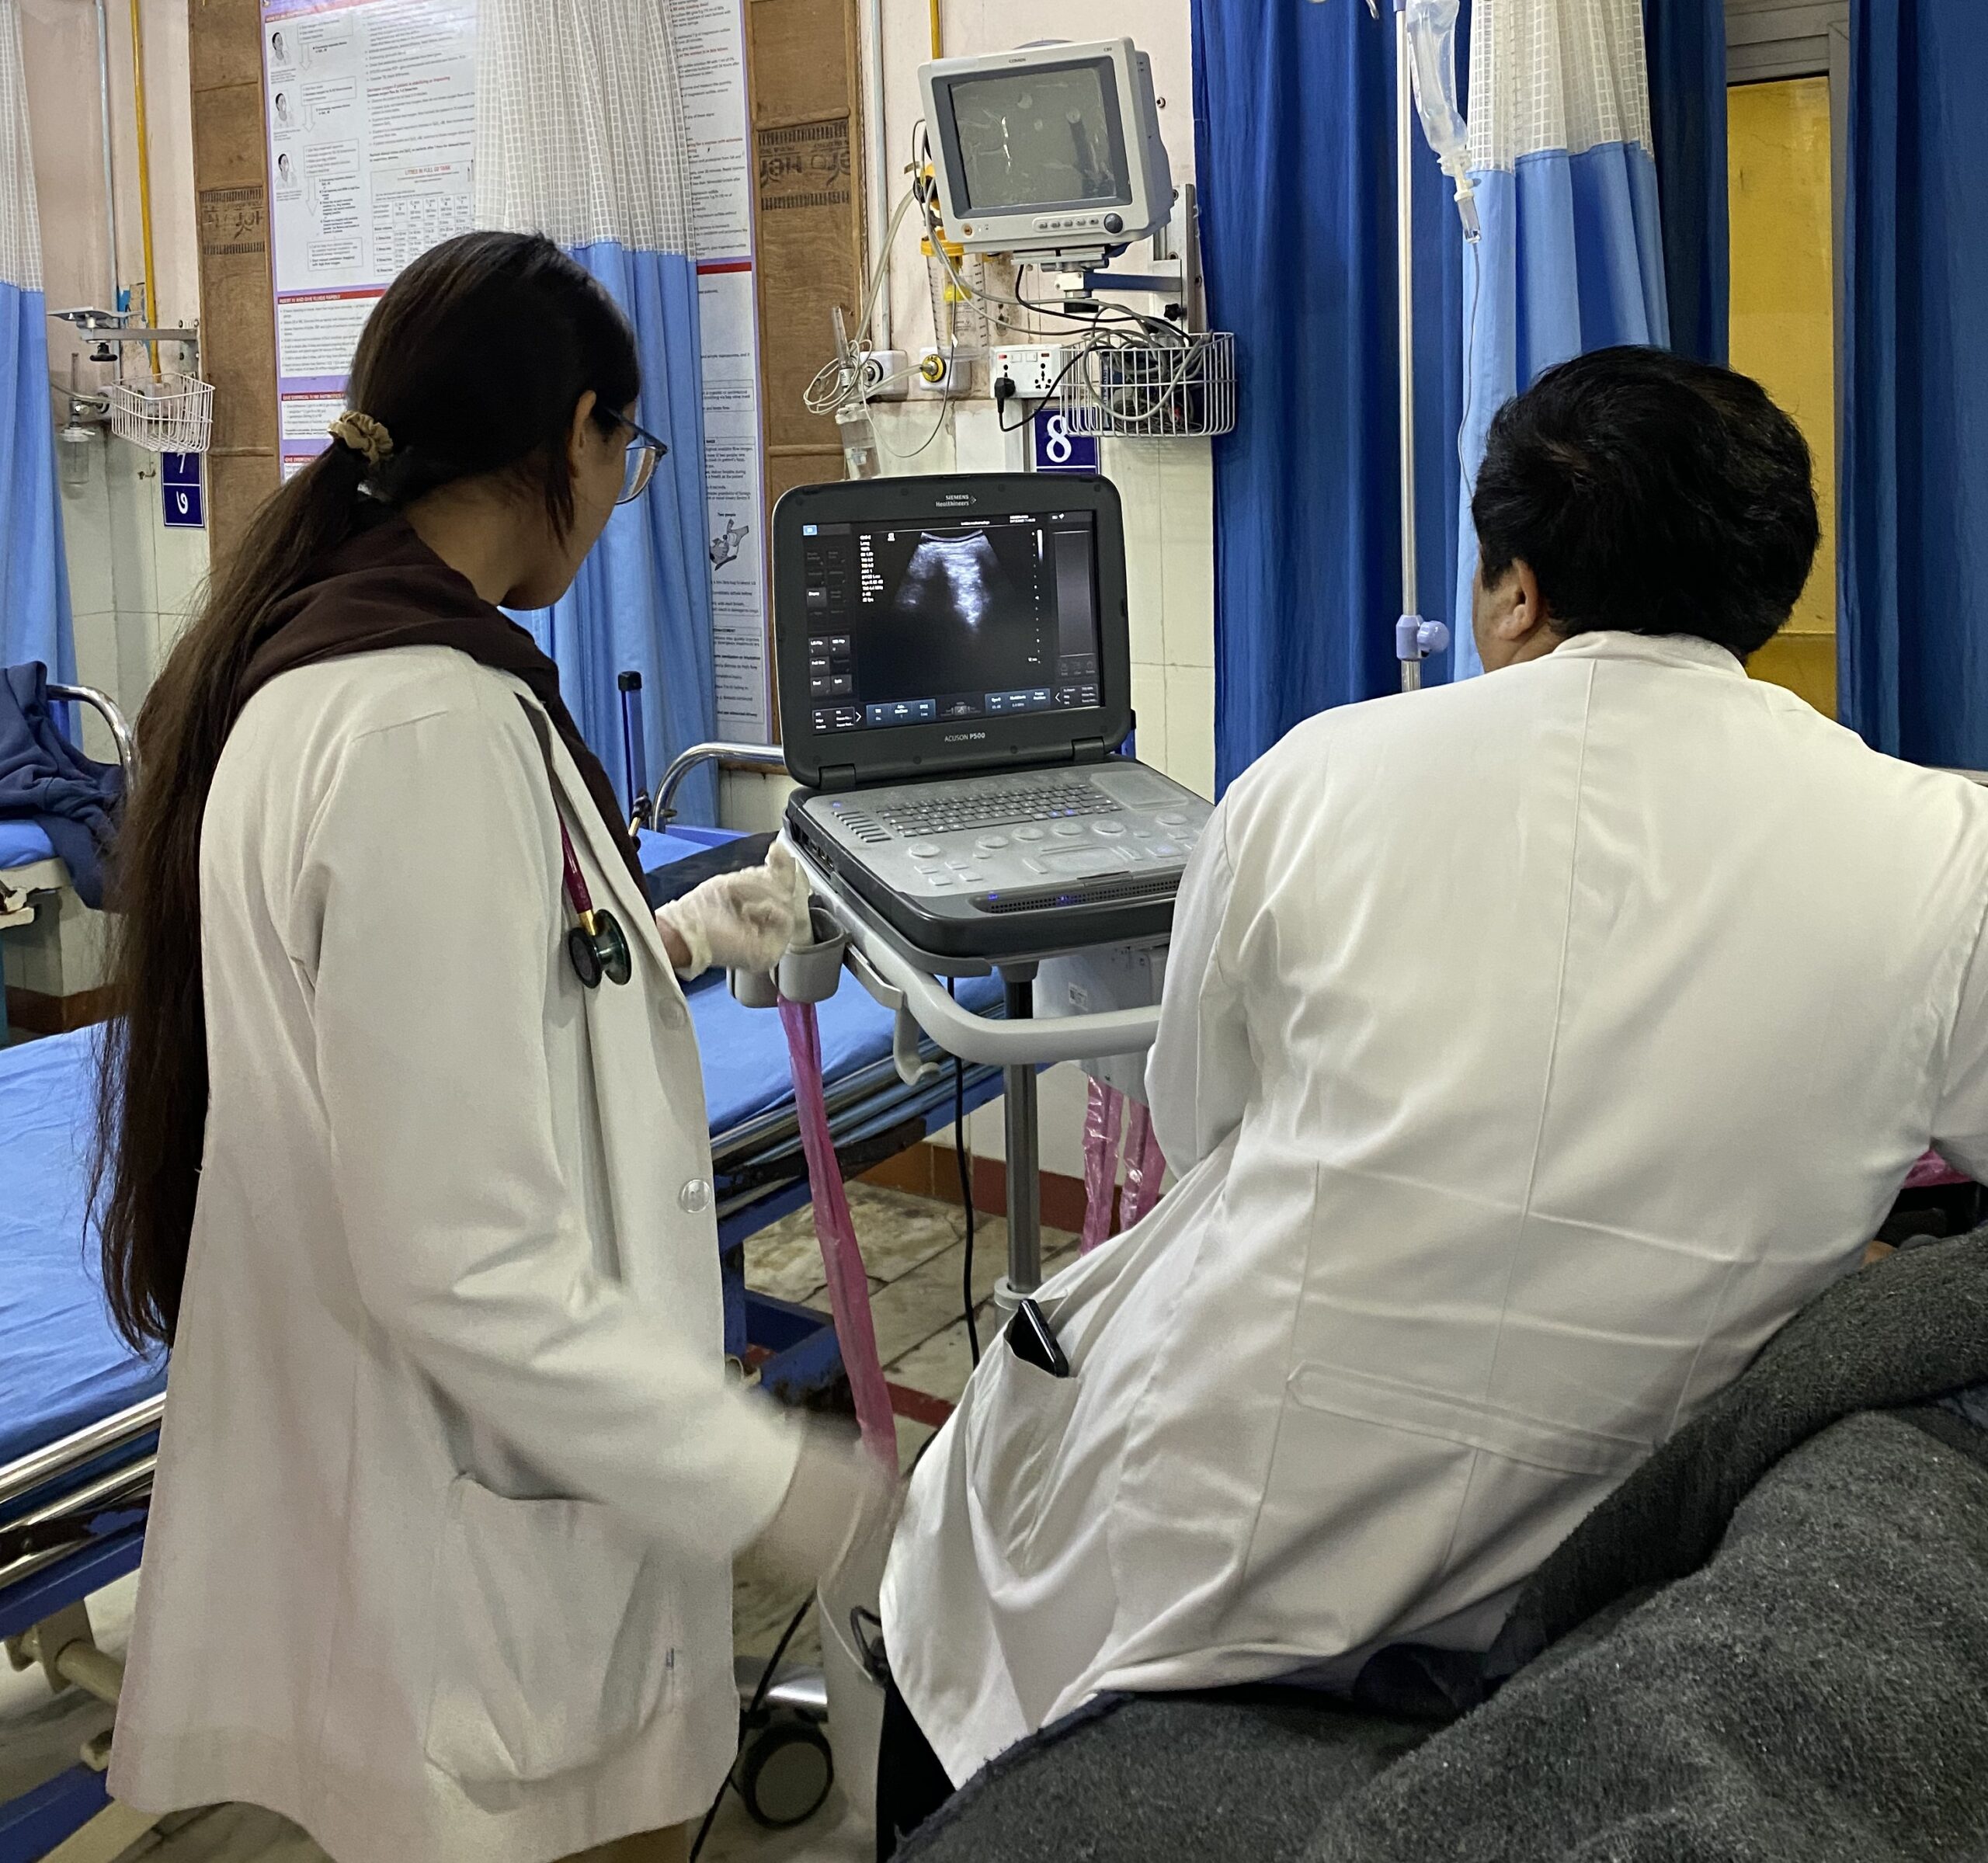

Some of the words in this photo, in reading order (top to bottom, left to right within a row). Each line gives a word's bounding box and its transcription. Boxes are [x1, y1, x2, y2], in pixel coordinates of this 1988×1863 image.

[1046, 415, 1072, 463] 8
[177, 452, 186, 473] 7
[944, 733, 968, 742] ACUSON
[969, 732, 985, 740] P500
